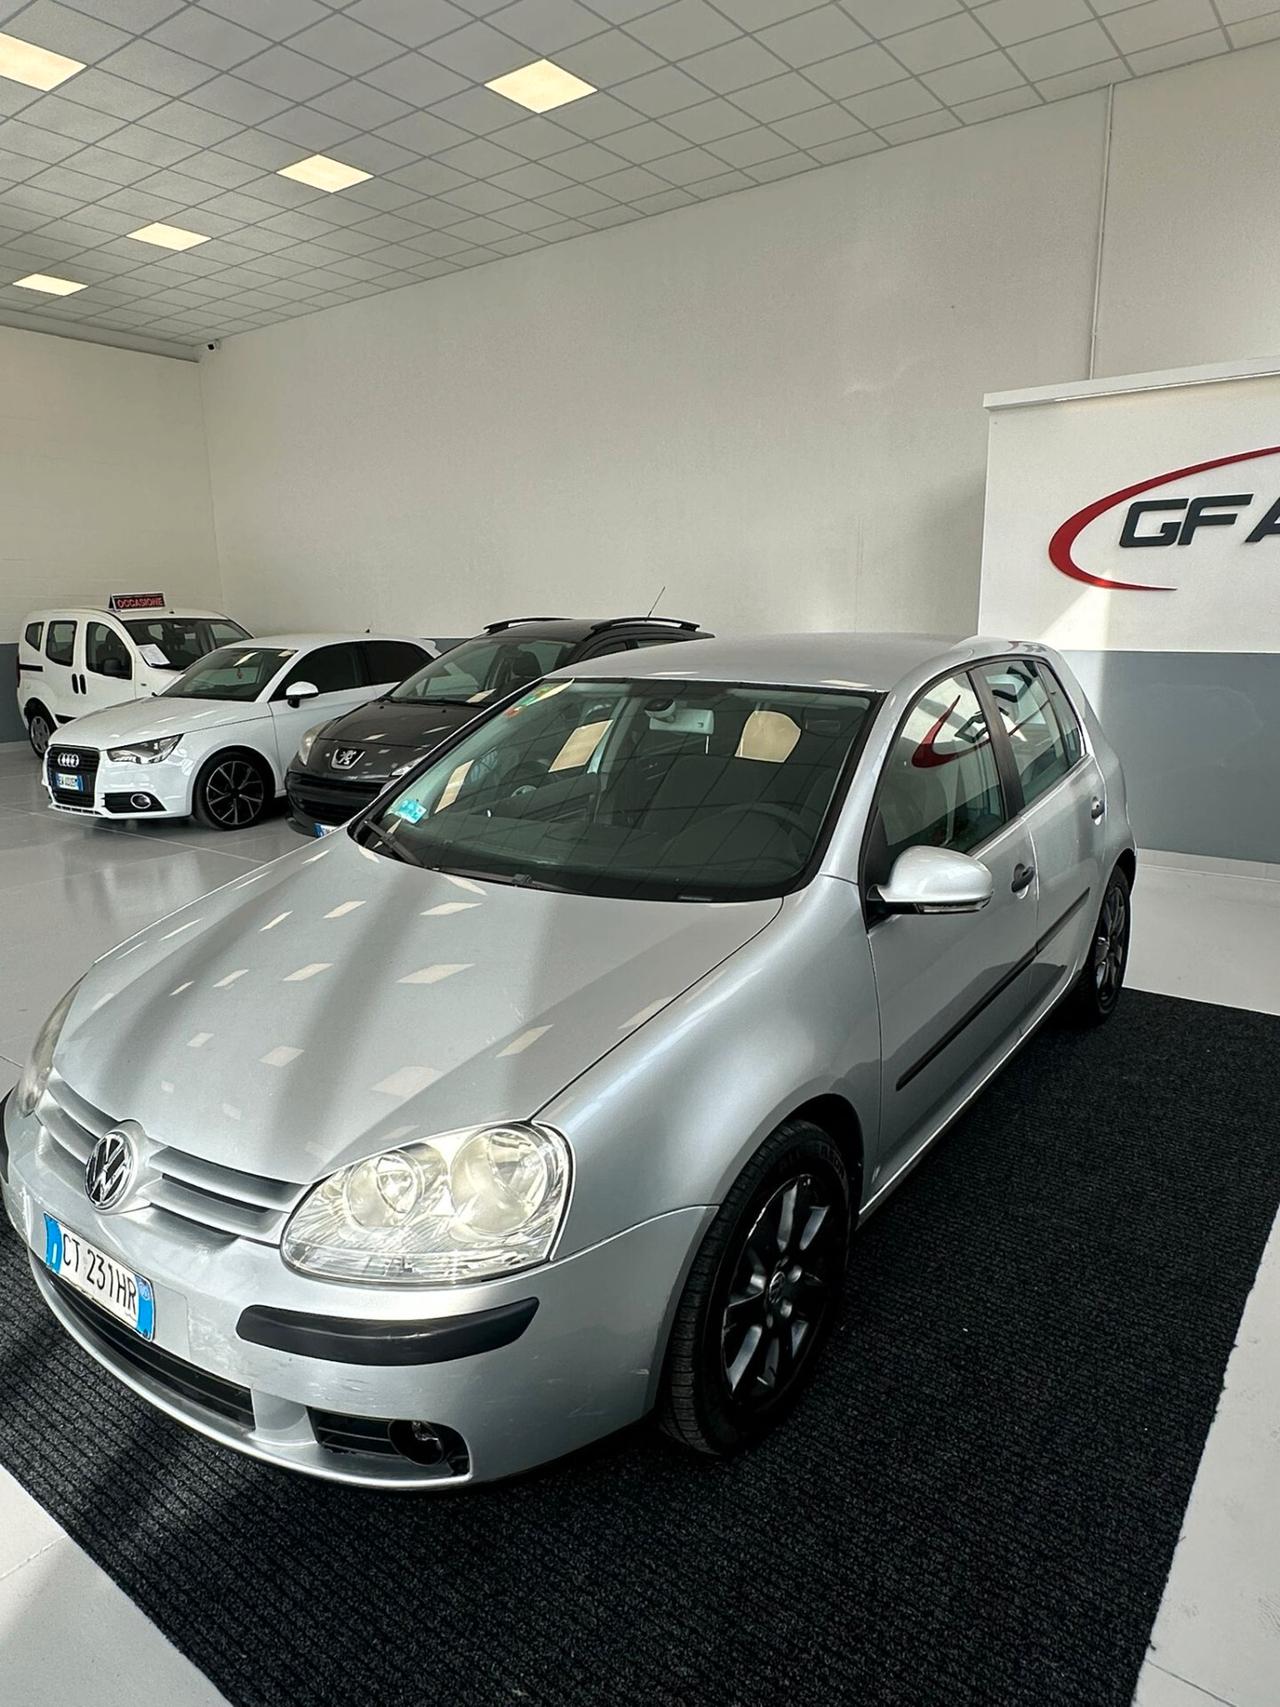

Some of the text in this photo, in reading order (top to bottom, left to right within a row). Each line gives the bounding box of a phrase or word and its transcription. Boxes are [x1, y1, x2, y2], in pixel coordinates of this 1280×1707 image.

[1119, 493, 1254, 547] GF
[117, 597, 163, 608] OCCASIONE
[63, 1233, 80, 1272] CT
[86, 1249, 137, 1315] 231HR
